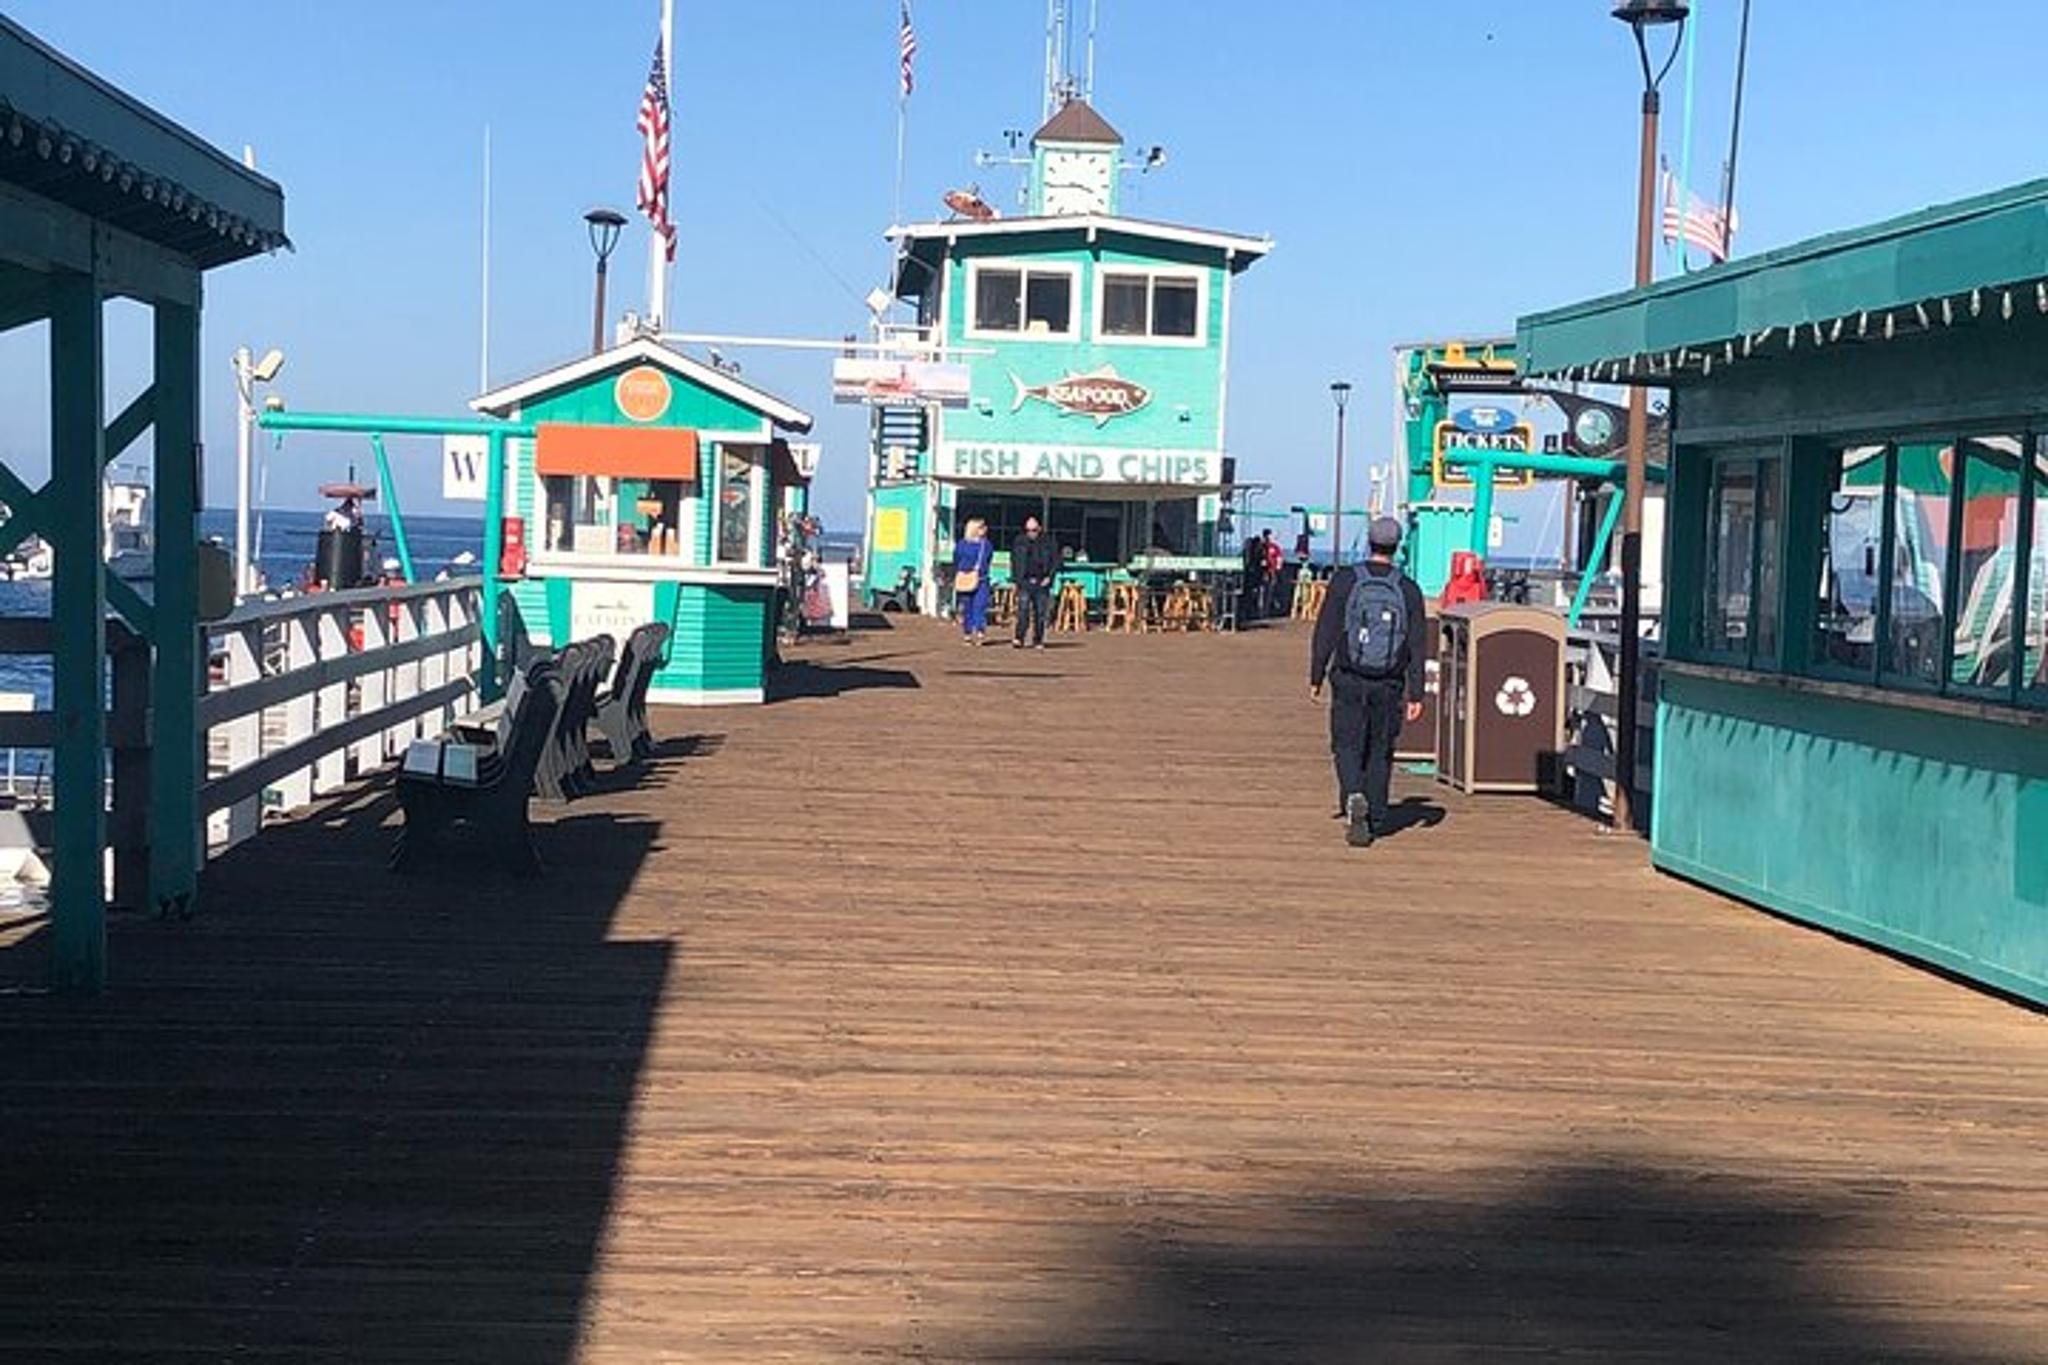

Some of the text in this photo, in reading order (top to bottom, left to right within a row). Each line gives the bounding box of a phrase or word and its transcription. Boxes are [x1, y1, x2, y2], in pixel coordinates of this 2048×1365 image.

[1049, 385, 1127, 405] SEAFOOD
[1444, 432, 1526, 450] TICKETS
[954, 448, 1210, 483] FISH AND CHIPS
